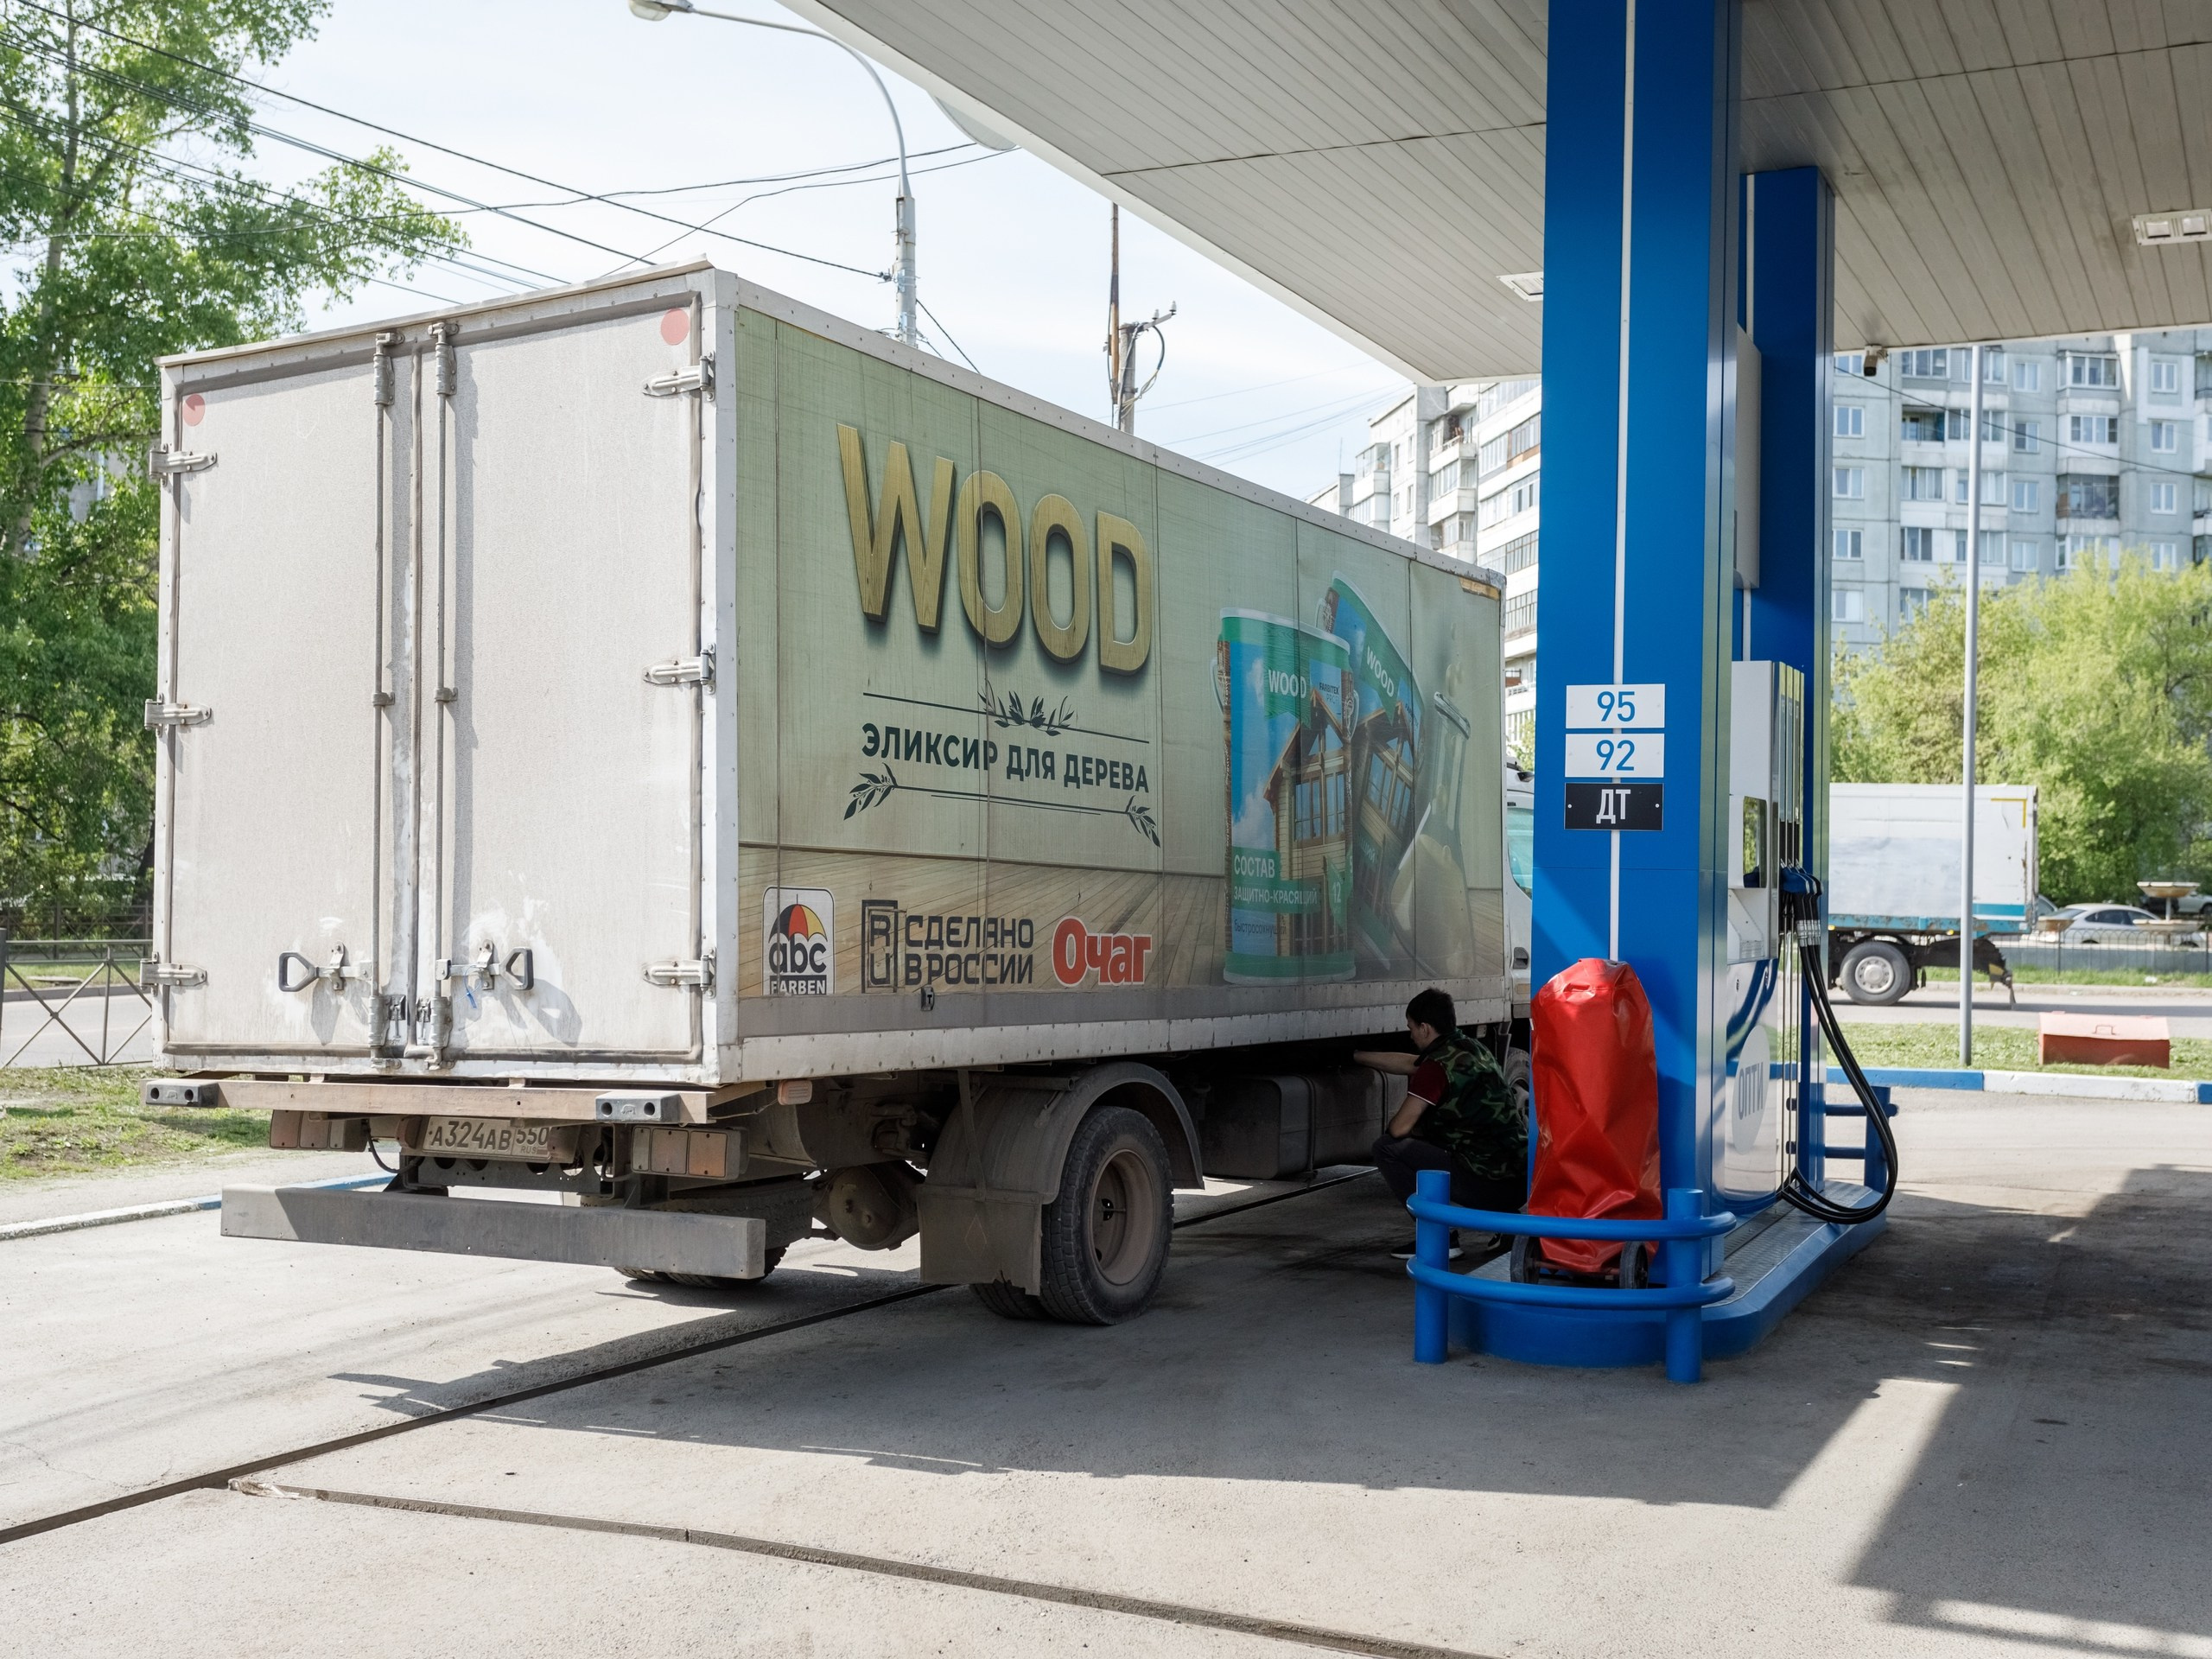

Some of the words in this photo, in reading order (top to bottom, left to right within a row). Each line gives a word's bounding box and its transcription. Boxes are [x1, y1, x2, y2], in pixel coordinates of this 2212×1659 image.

[836, 423, 1154, 676] WOOD
[1268, 669, 1307, 699] WOOD
[1366, 645, 1395, 697] WOOD
[1596, 690, 1637, 722] 95
[861, 722, 998, 771] ЭЛИКСИР
[1006, 745, 1056, 781] ДЛЯ
[1063, 753, 1150, 794] ДЕРЕВА
[1595, 739, 1636, 772] 92
[1595, 788, 1631, 824] ДТ
[1234, 854, 1275, 879] СОСТАВ
[1233, 885, 1318, 906] ЗАЩИТНО-КРАСЯЩИЙ
[870, 914, 892, 947] R
[905, 915, 1034, 950] СДЕЛАНО
[768, 933, 828, 975] abc
[1052, 916, 1153, 988] Очаг
[869, 953, 892, 986] U
[771, 979, 827, 995] FARBEN
[1738, 1061, 1764, 1121] ОПТИ
[432, 1120, 512, 1152] А324АВ
[516, 1126, 550, 1146] 550
[520, 1146, 537, 1155] RUS
